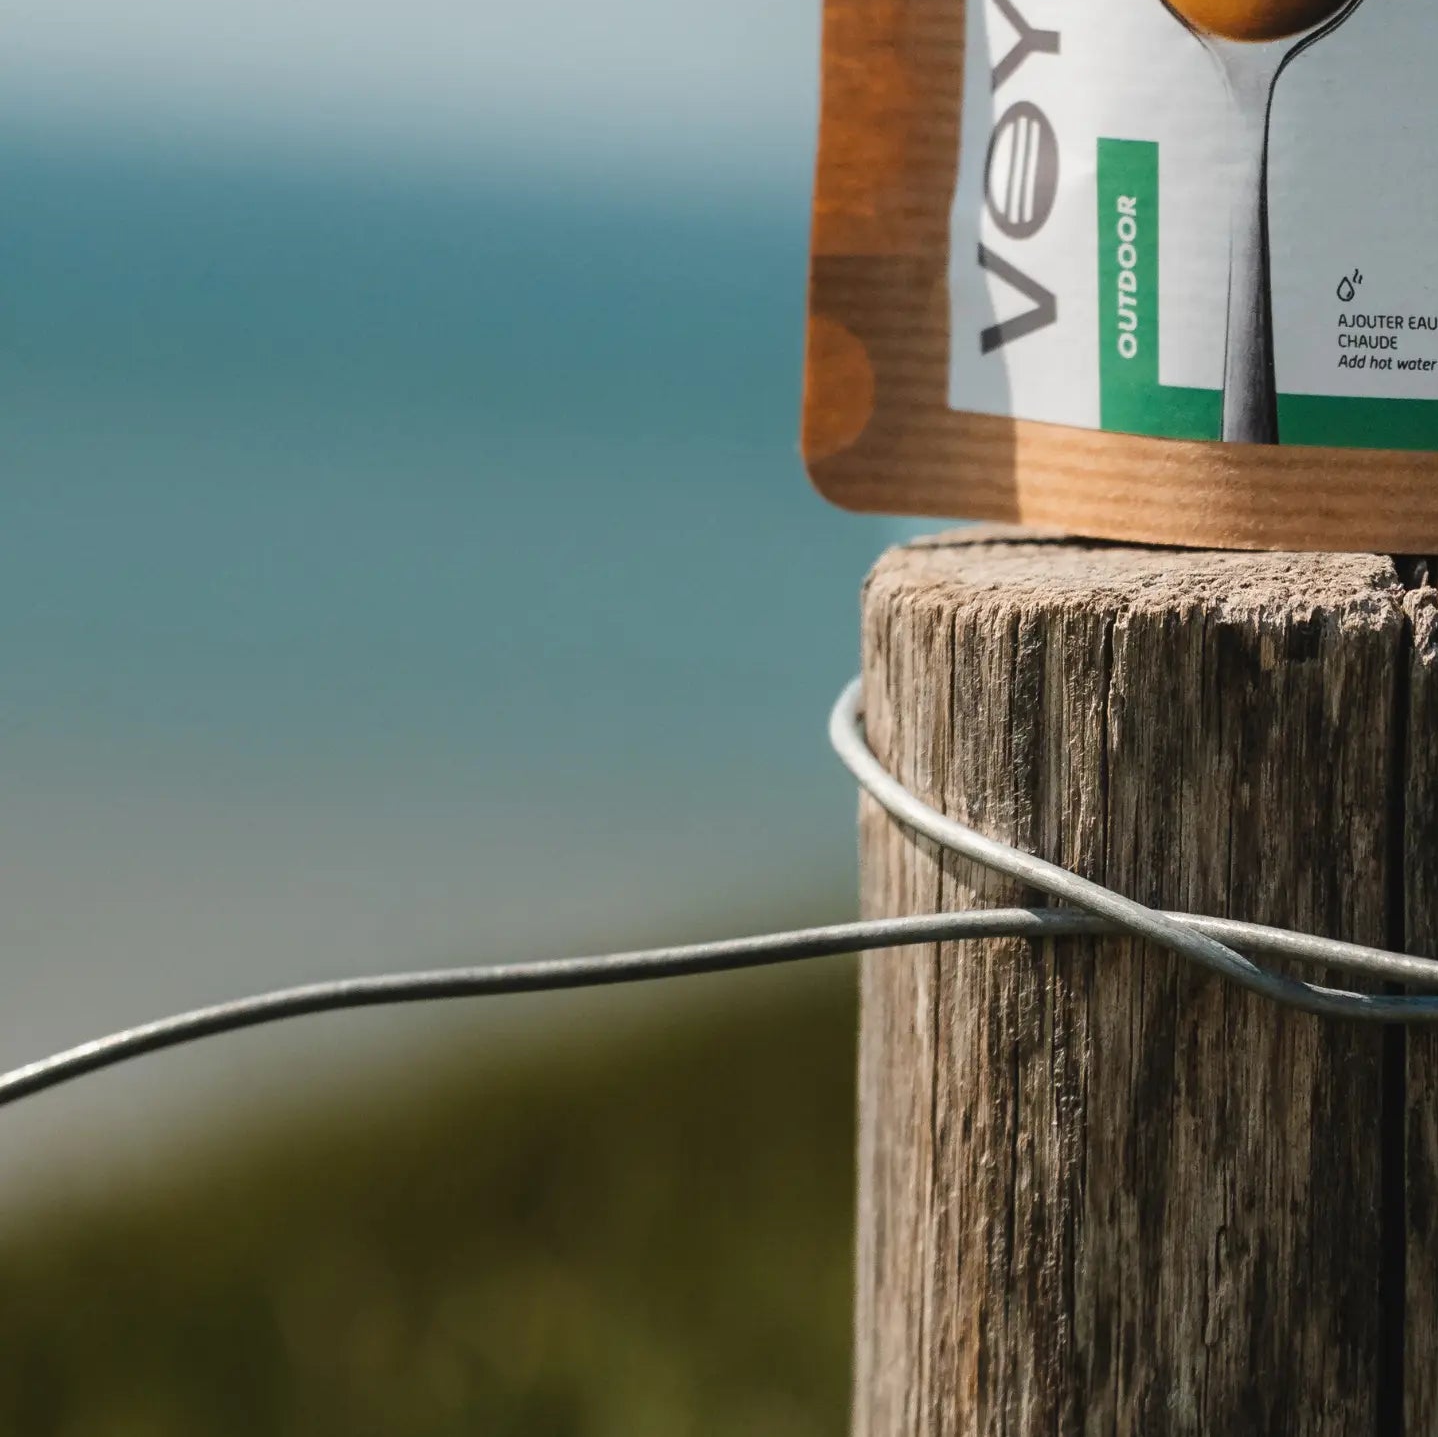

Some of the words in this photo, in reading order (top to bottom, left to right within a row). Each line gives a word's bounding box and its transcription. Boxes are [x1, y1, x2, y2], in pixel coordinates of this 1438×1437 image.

[1116, 195, 1139, 359] OUTDOOR
[1338, 314, 1404, 330] AJOUTER
[1408, 316, 1438, 331] EAU
[1337, 335, 1398, 350] CHAUDE
[1337, 354, 1366, 370] Add
[1369, 355, 1394, 371] hot
[1397, 357, 1438, 371] water
